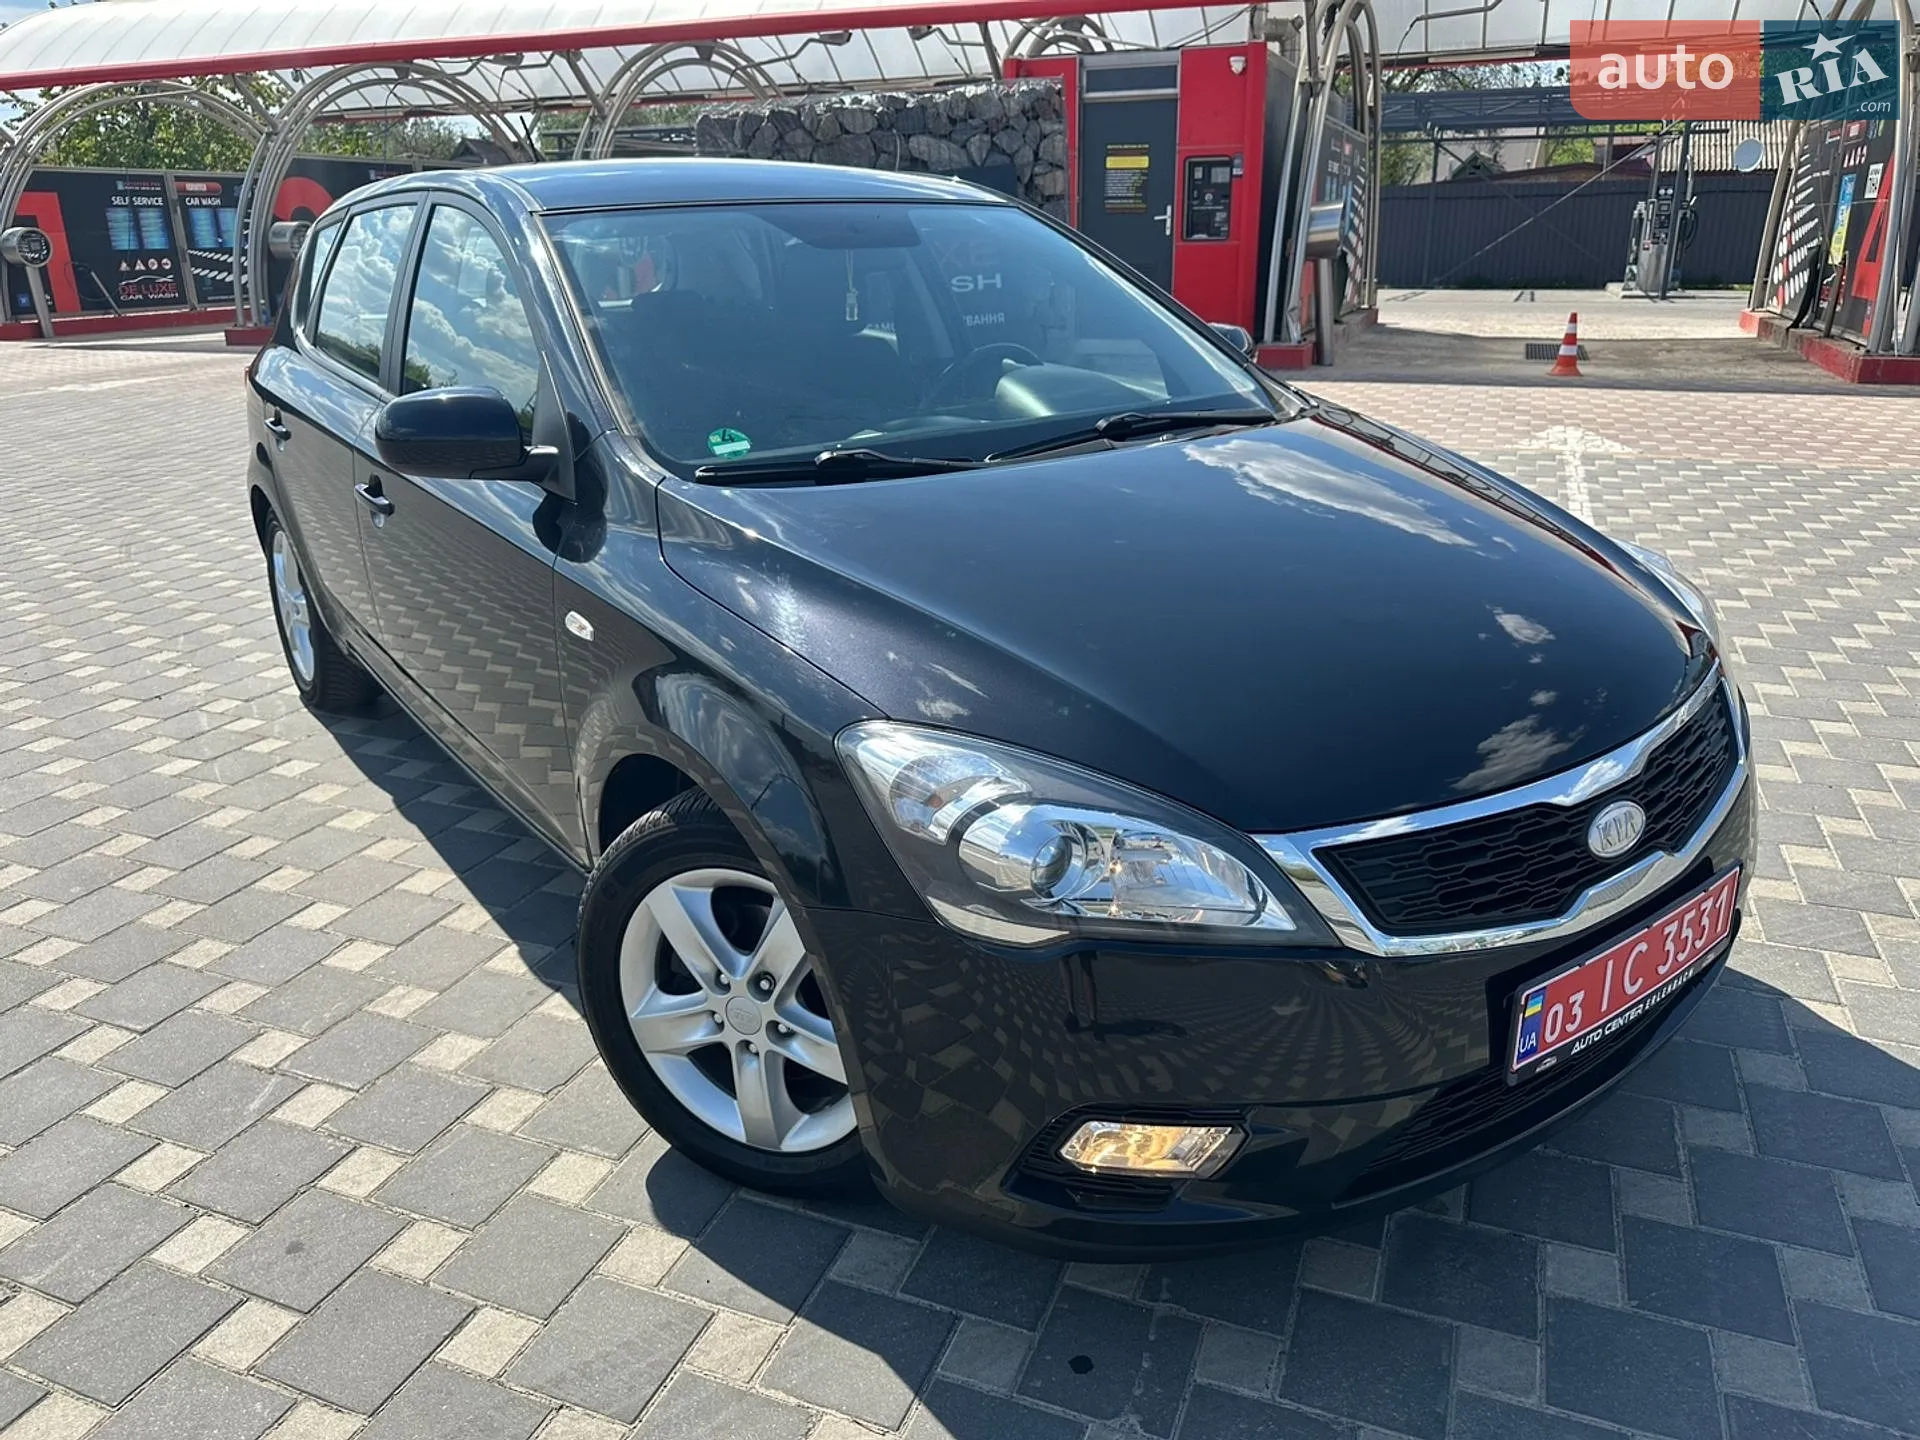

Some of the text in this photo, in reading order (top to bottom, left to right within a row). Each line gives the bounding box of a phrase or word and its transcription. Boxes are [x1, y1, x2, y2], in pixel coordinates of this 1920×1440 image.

[111, 196, 164, 206] SELF SERVICE
[185, 197, 221, 206] CAR WASH
[119, 282, 177, 295] DE LUXE
[148, 292, 179, 300] WASH
[1596, 809, 1637, 851] KIA
[1543, 885, 1730, 1044] 03 IC 3531
[1571, 1029, 1602, 1055] AUTO
[1604, 1003, 1644, 1036] CENTER
[1519, 1032, 1537, 1053] UA
